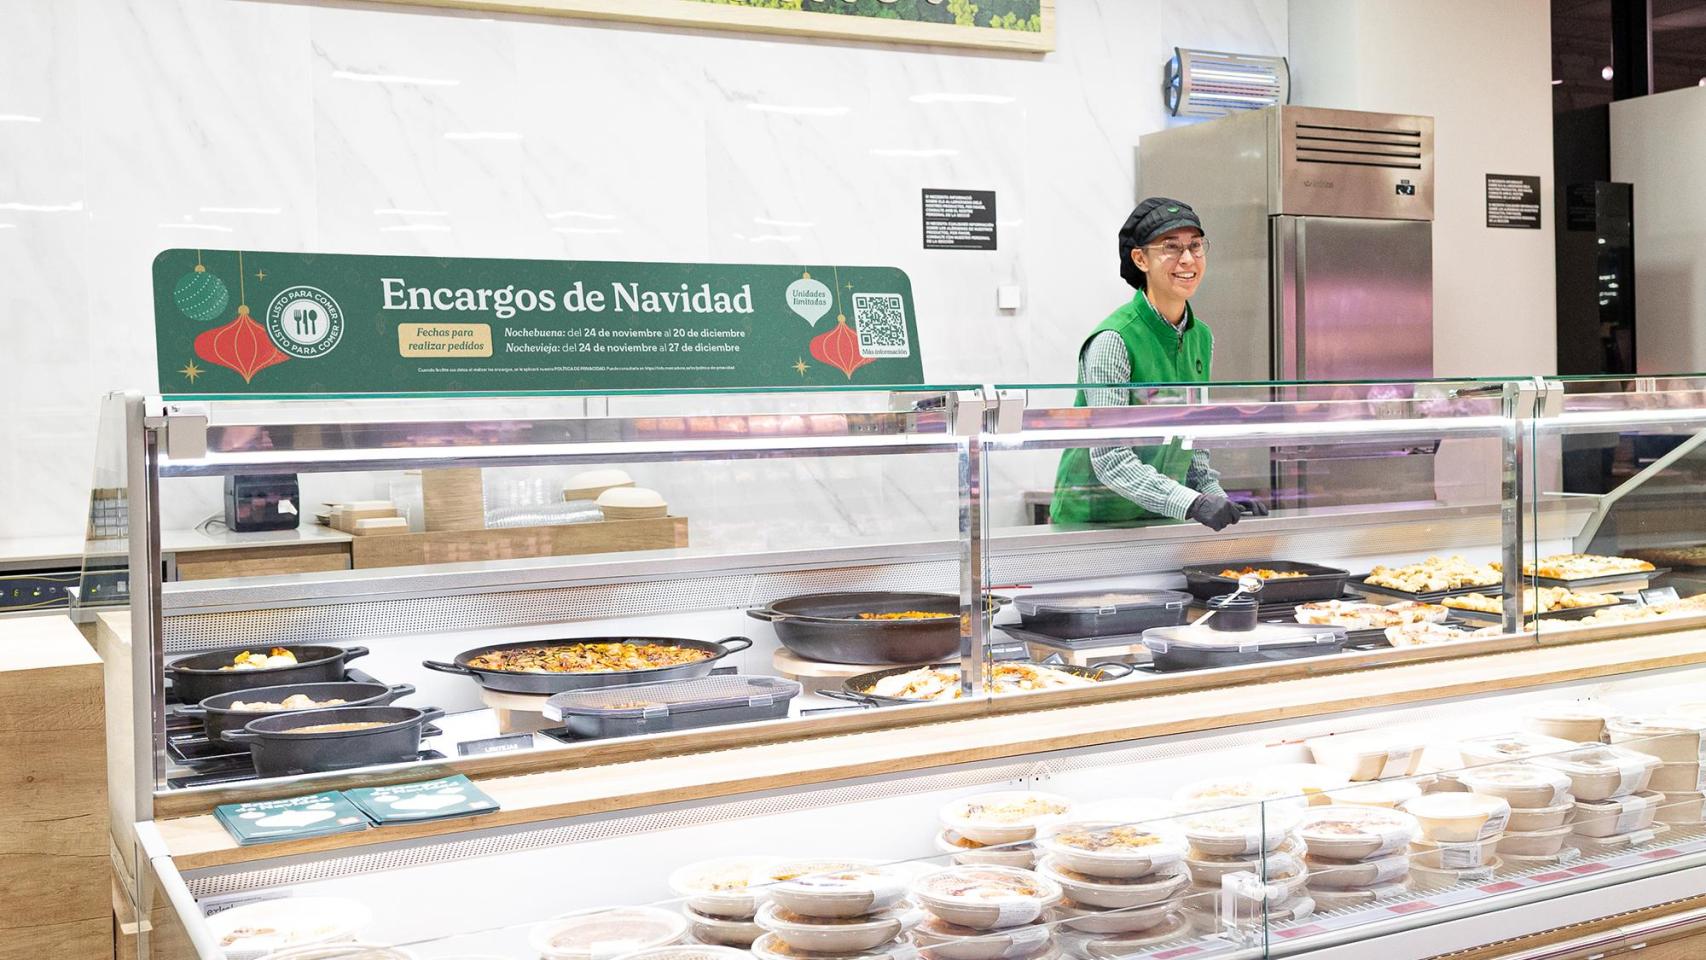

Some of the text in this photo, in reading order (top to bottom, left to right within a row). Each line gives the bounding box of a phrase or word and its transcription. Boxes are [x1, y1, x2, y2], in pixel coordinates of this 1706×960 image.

[381, 278, 754, 319] Encargos de Navidad
[793, 290, 826, 298] Unidades
[271, 290, 338, 319] LISTO PARA COMER
[793, 298, 827, 306] limitadas
[416, 327, 474, 340] Fechas para
[504, 327, 746, 338] Nochebuena: del 24 de noviembre al 20 de diciembre
[271, 324, 340, 354] LISTO PARA COMER
[408, 341, 484, 352] realizar pedidos
[505, 342, 740, 354] Nochevieja: del 24 de noviembre al 27 de diciembre
[875, 348, 908, 356] información
